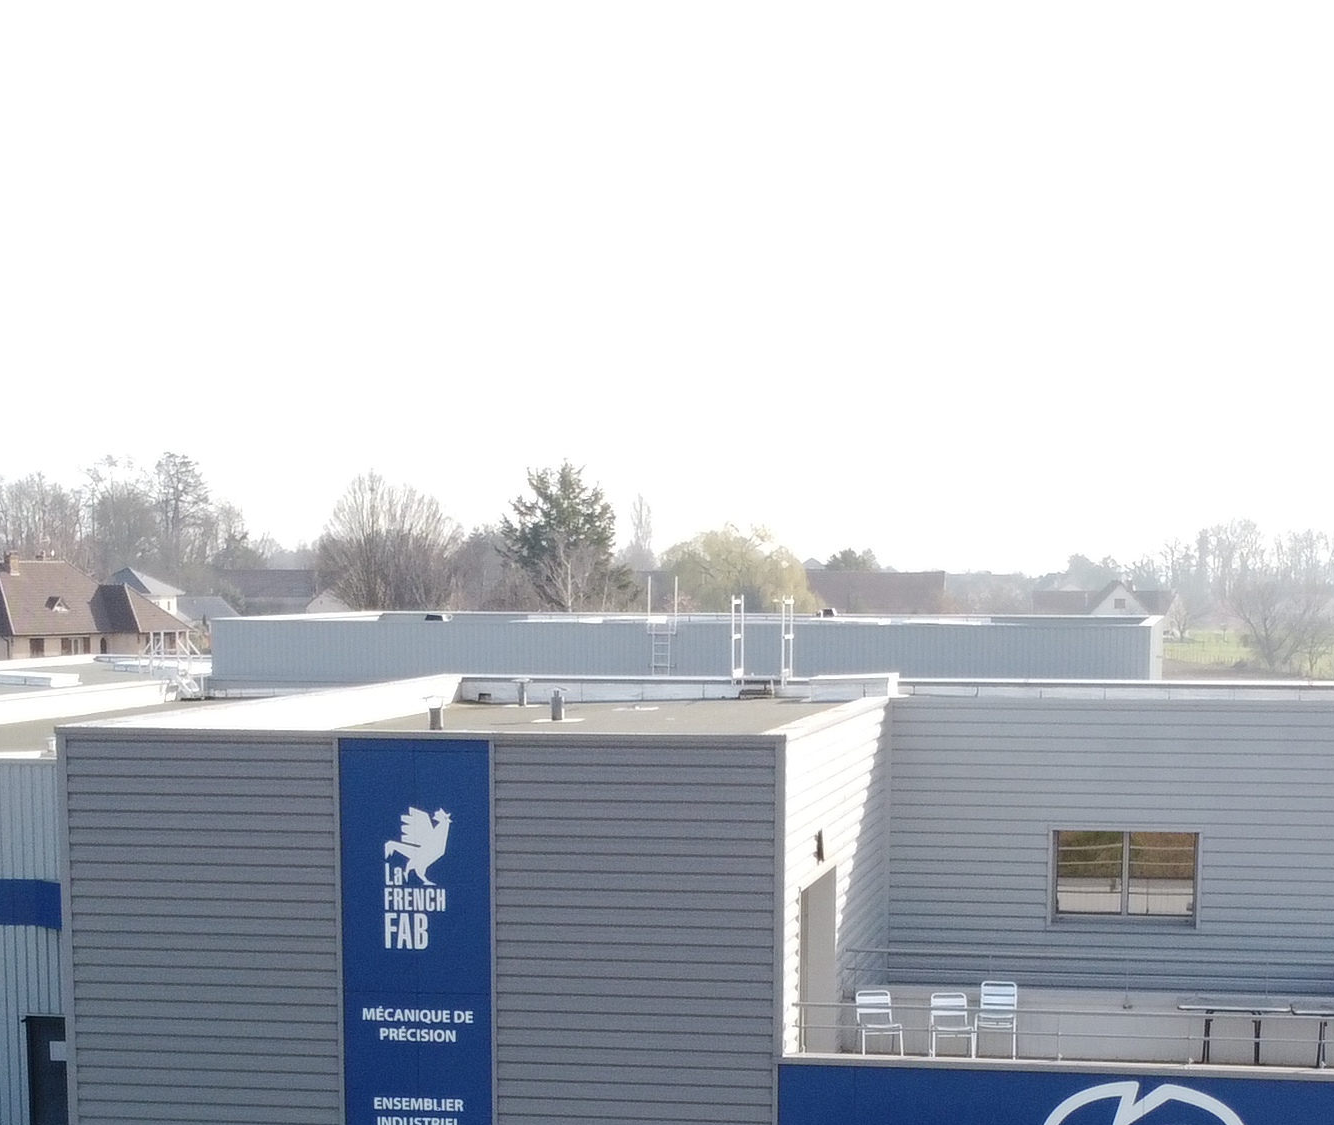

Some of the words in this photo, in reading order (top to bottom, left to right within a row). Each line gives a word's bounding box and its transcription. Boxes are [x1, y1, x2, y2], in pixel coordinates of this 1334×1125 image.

[384, 863, 403, 886] La
[384, 888, 446, 912] FRENCH
[384, 913, 429, 950] FAB
[362, 1005, 451, 1024] MÉCANIQUE
[453, 1010, 474, 1024] DE
[379, 1026, 457, 1043] PRÉCISION
[373, 1097, 464, 1112] ENSEMBLIER
